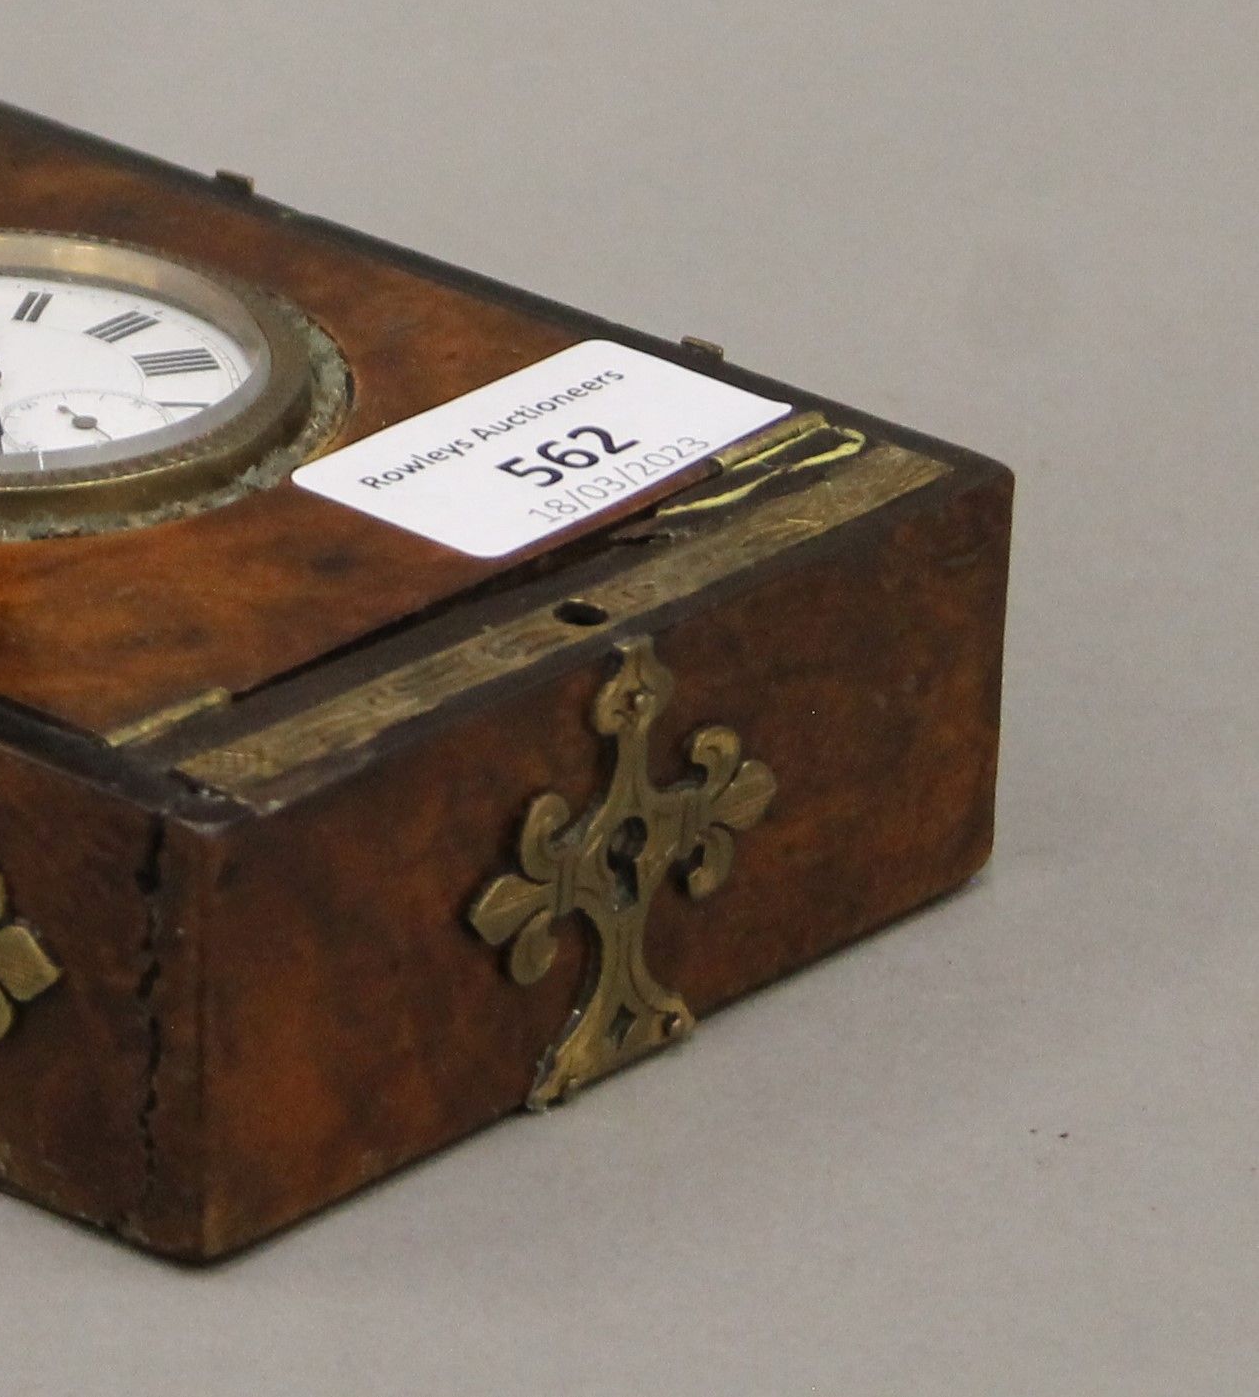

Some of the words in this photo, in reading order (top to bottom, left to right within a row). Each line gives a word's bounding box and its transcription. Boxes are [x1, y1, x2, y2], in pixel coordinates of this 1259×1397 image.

[358, 436, 474, 490] Rowleys
[470, 367, 625, 441] Auctioneers
[494, 424, 641, 488] 562
[528, 435, 711, 524] 18/03/2023
